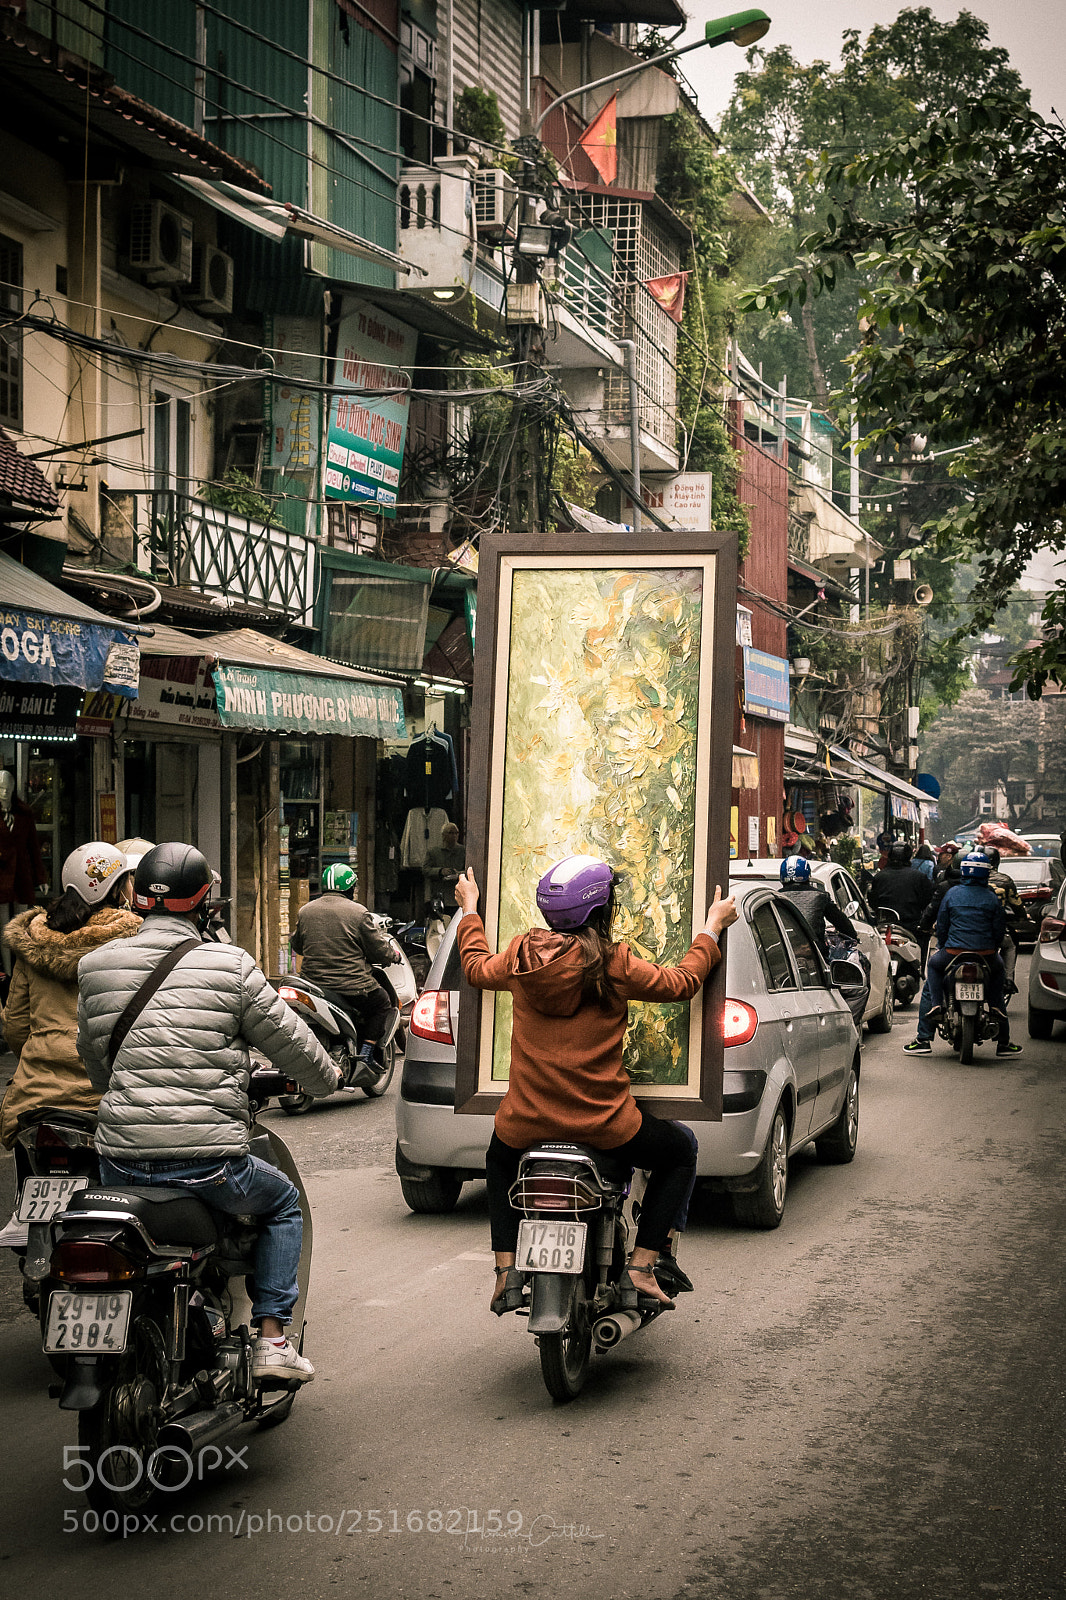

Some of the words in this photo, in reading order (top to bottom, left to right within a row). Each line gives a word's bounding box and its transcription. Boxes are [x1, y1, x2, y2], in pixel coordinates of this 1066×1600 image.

[369, 413, 386, 450] HỌC
[385, 420, 402, 454] SINH
[370, 461, 383, 477] PLUS
[0, 627, 57, 668] OGA
[20, 693, 43, 715] BÁN
[224, 686, 268, 716] MINH
[270, 691, 336, 722] PHƯƠNG
[102, 859, 121, 878] GOOD
[26, 1200, 69, 1220] 272
[84, 1194, 130, 1205] HONDA
[530, 1224, 577, 1247] 17-H6
[526, 1246, 575, 1270] 4603
[58, 1295, 121, 1321] 29-N9
[55, 1322, 115, 1349] 2984
